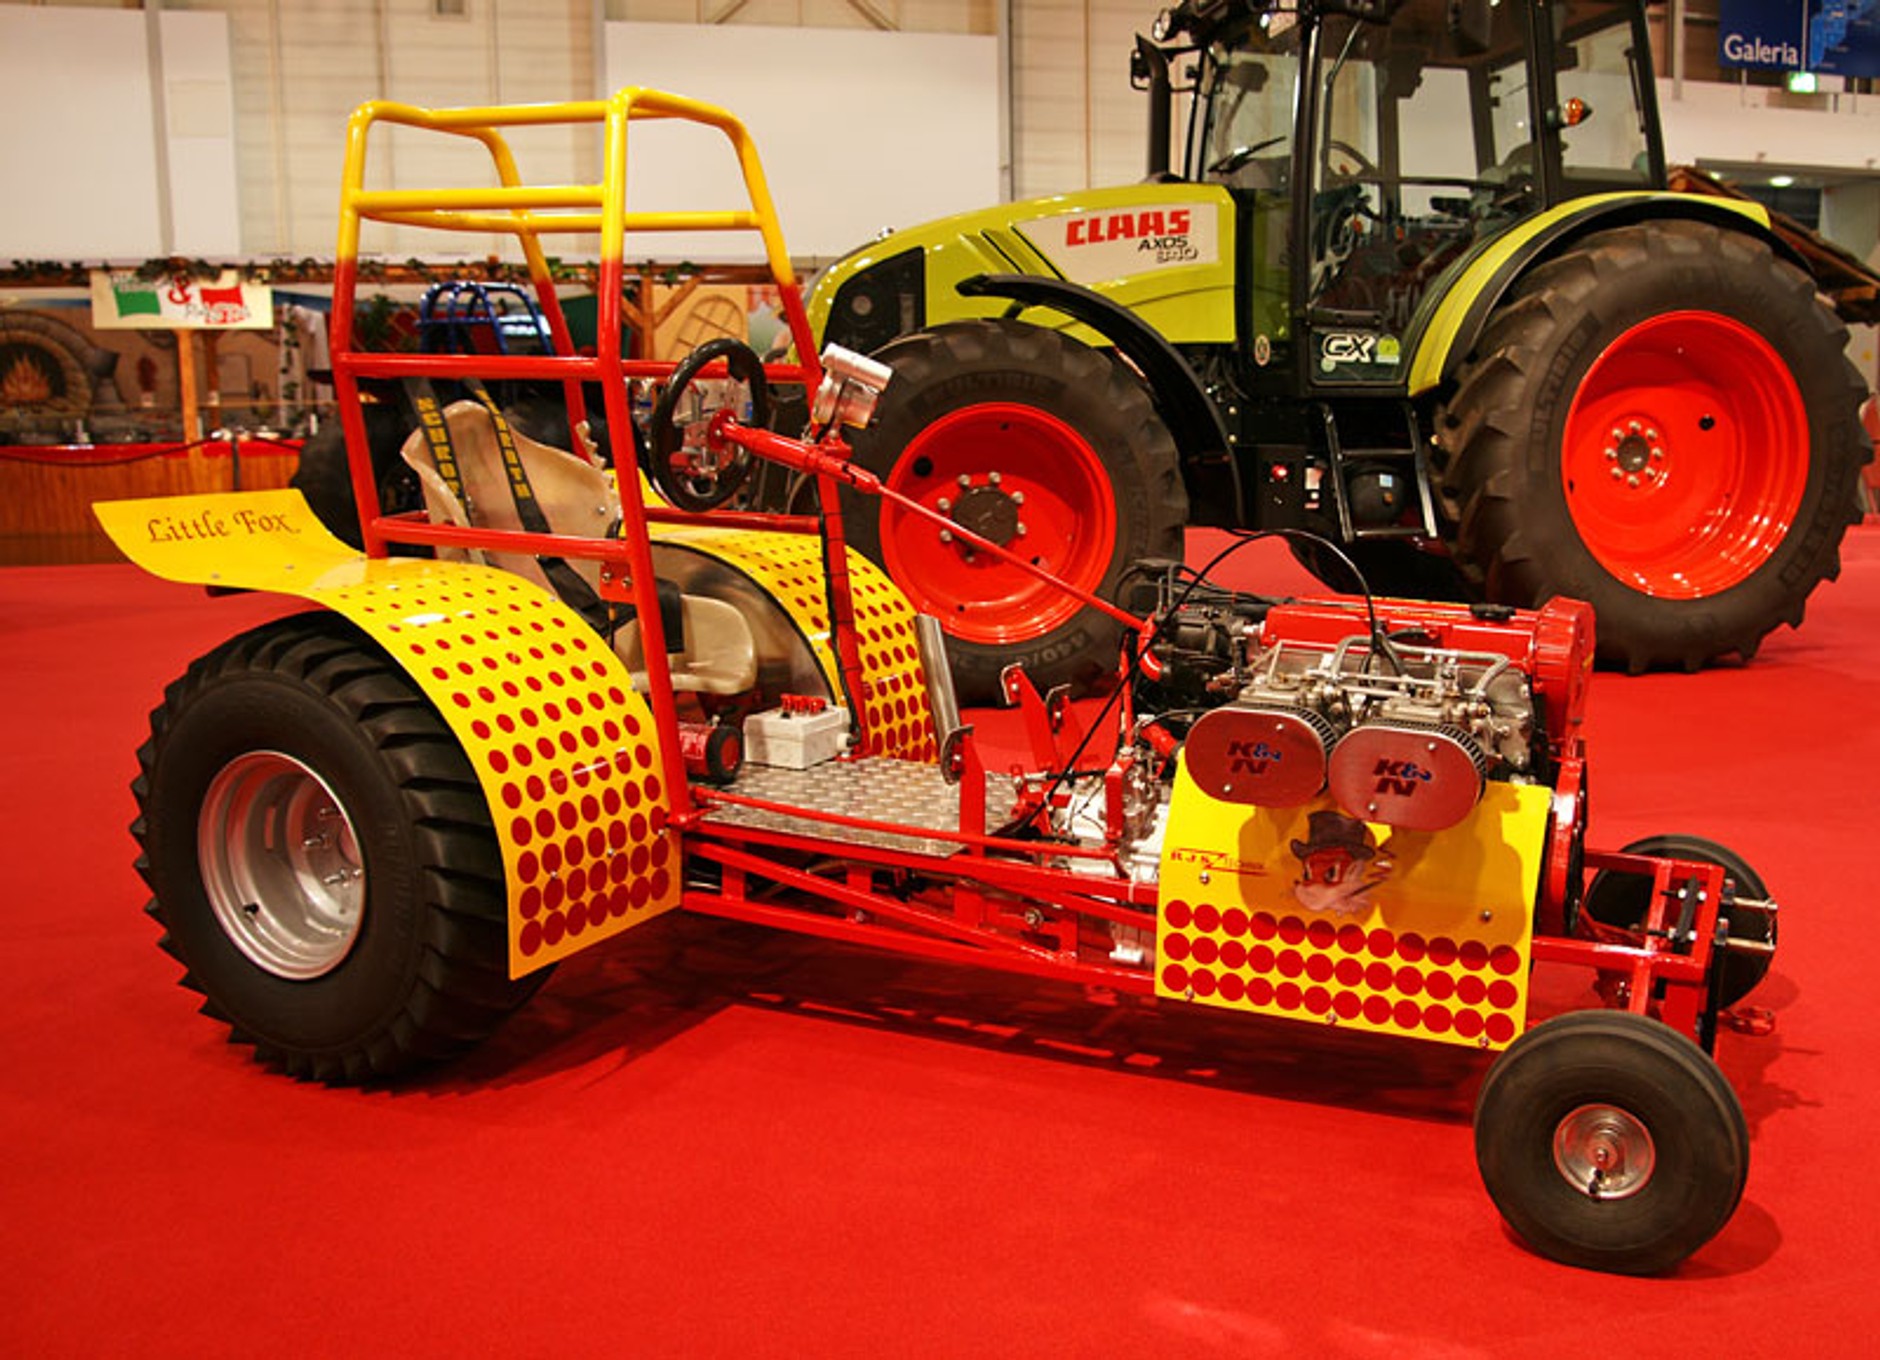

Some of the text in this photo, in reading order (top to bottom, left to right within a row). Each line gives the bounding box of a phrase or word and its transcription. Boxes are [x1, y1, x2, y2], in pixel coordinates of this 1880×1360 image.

[1724, 33, 1799, 65] Galeria
[1066, 209, 1191, 247] CLAAS
[1138, 235, 1189, 251] AXOS
[1323, 333, 1376, 363] CX
[148, 509, 302, 543] Little Fox
